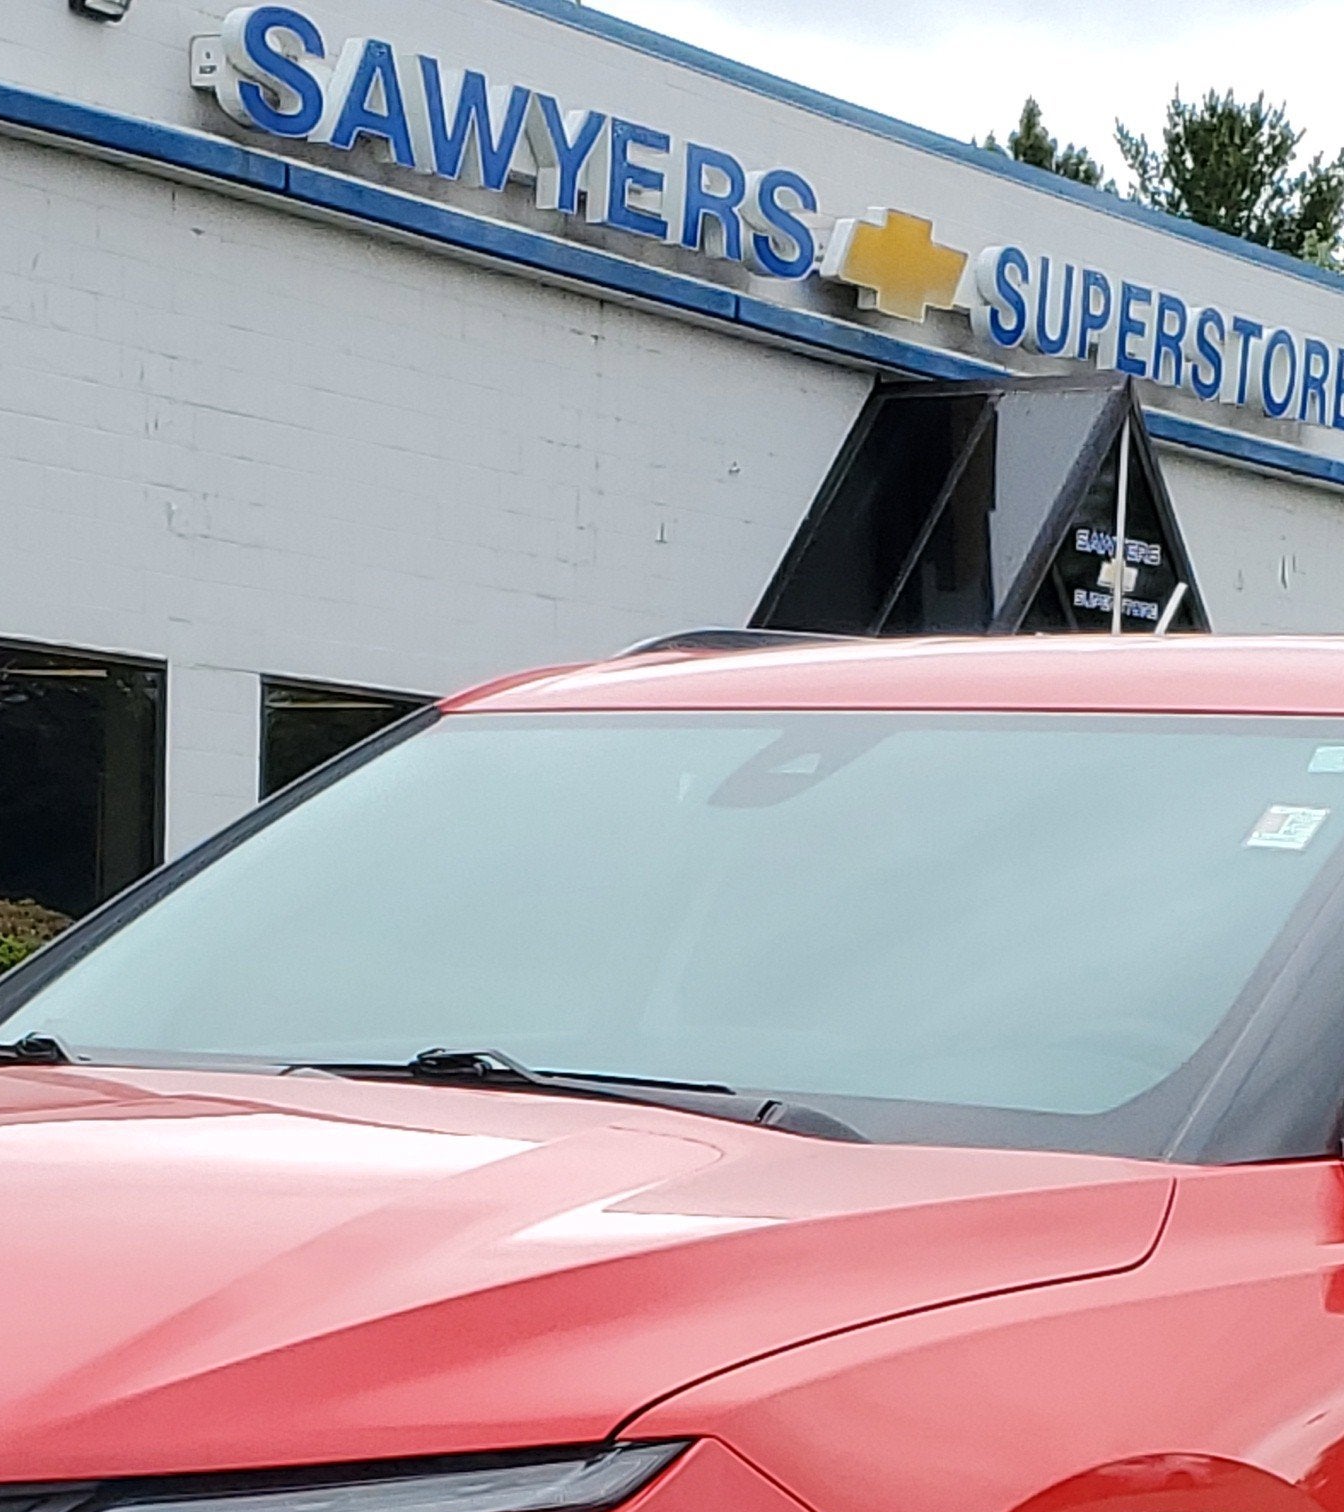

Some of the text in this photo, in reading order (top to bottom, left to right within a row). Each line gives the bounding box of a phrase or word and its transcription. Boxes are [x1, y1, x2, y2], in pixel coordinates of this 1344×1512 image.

[234, 5, 819, 280] SAWYERS
[1076, 529, 1161, 566] SAWERS
[1074, 589, 1158, 620] SUPERTORE
